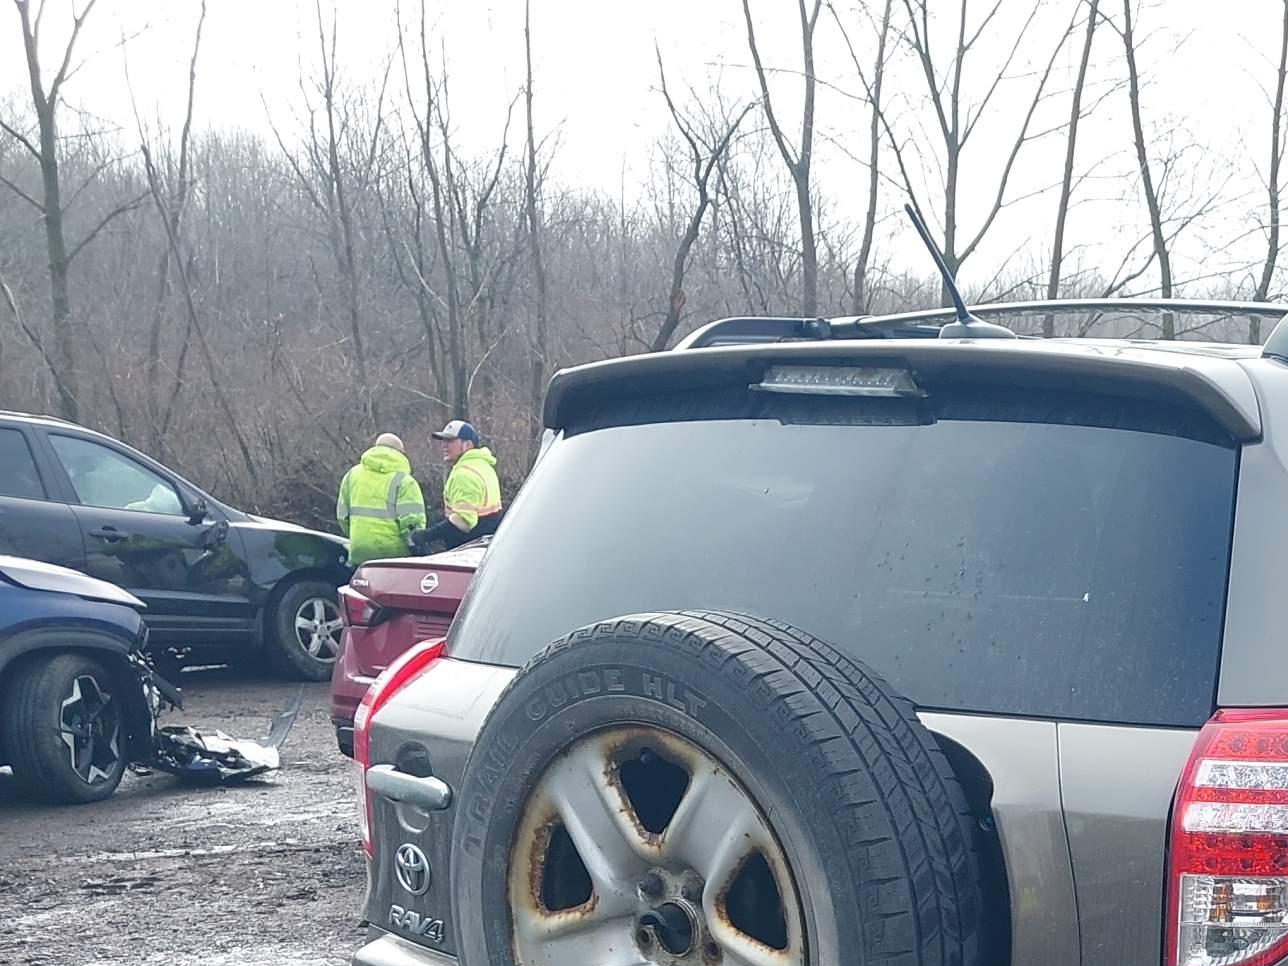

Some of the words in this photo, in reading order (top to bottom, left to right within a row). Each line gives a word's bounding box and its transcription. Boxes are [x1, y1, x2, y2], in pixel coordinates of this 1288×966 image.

[526, 668, 625, 722] GUIDE
[641, 672, 706, 718] HLT
[388, 904, 445, 943] RAV4
